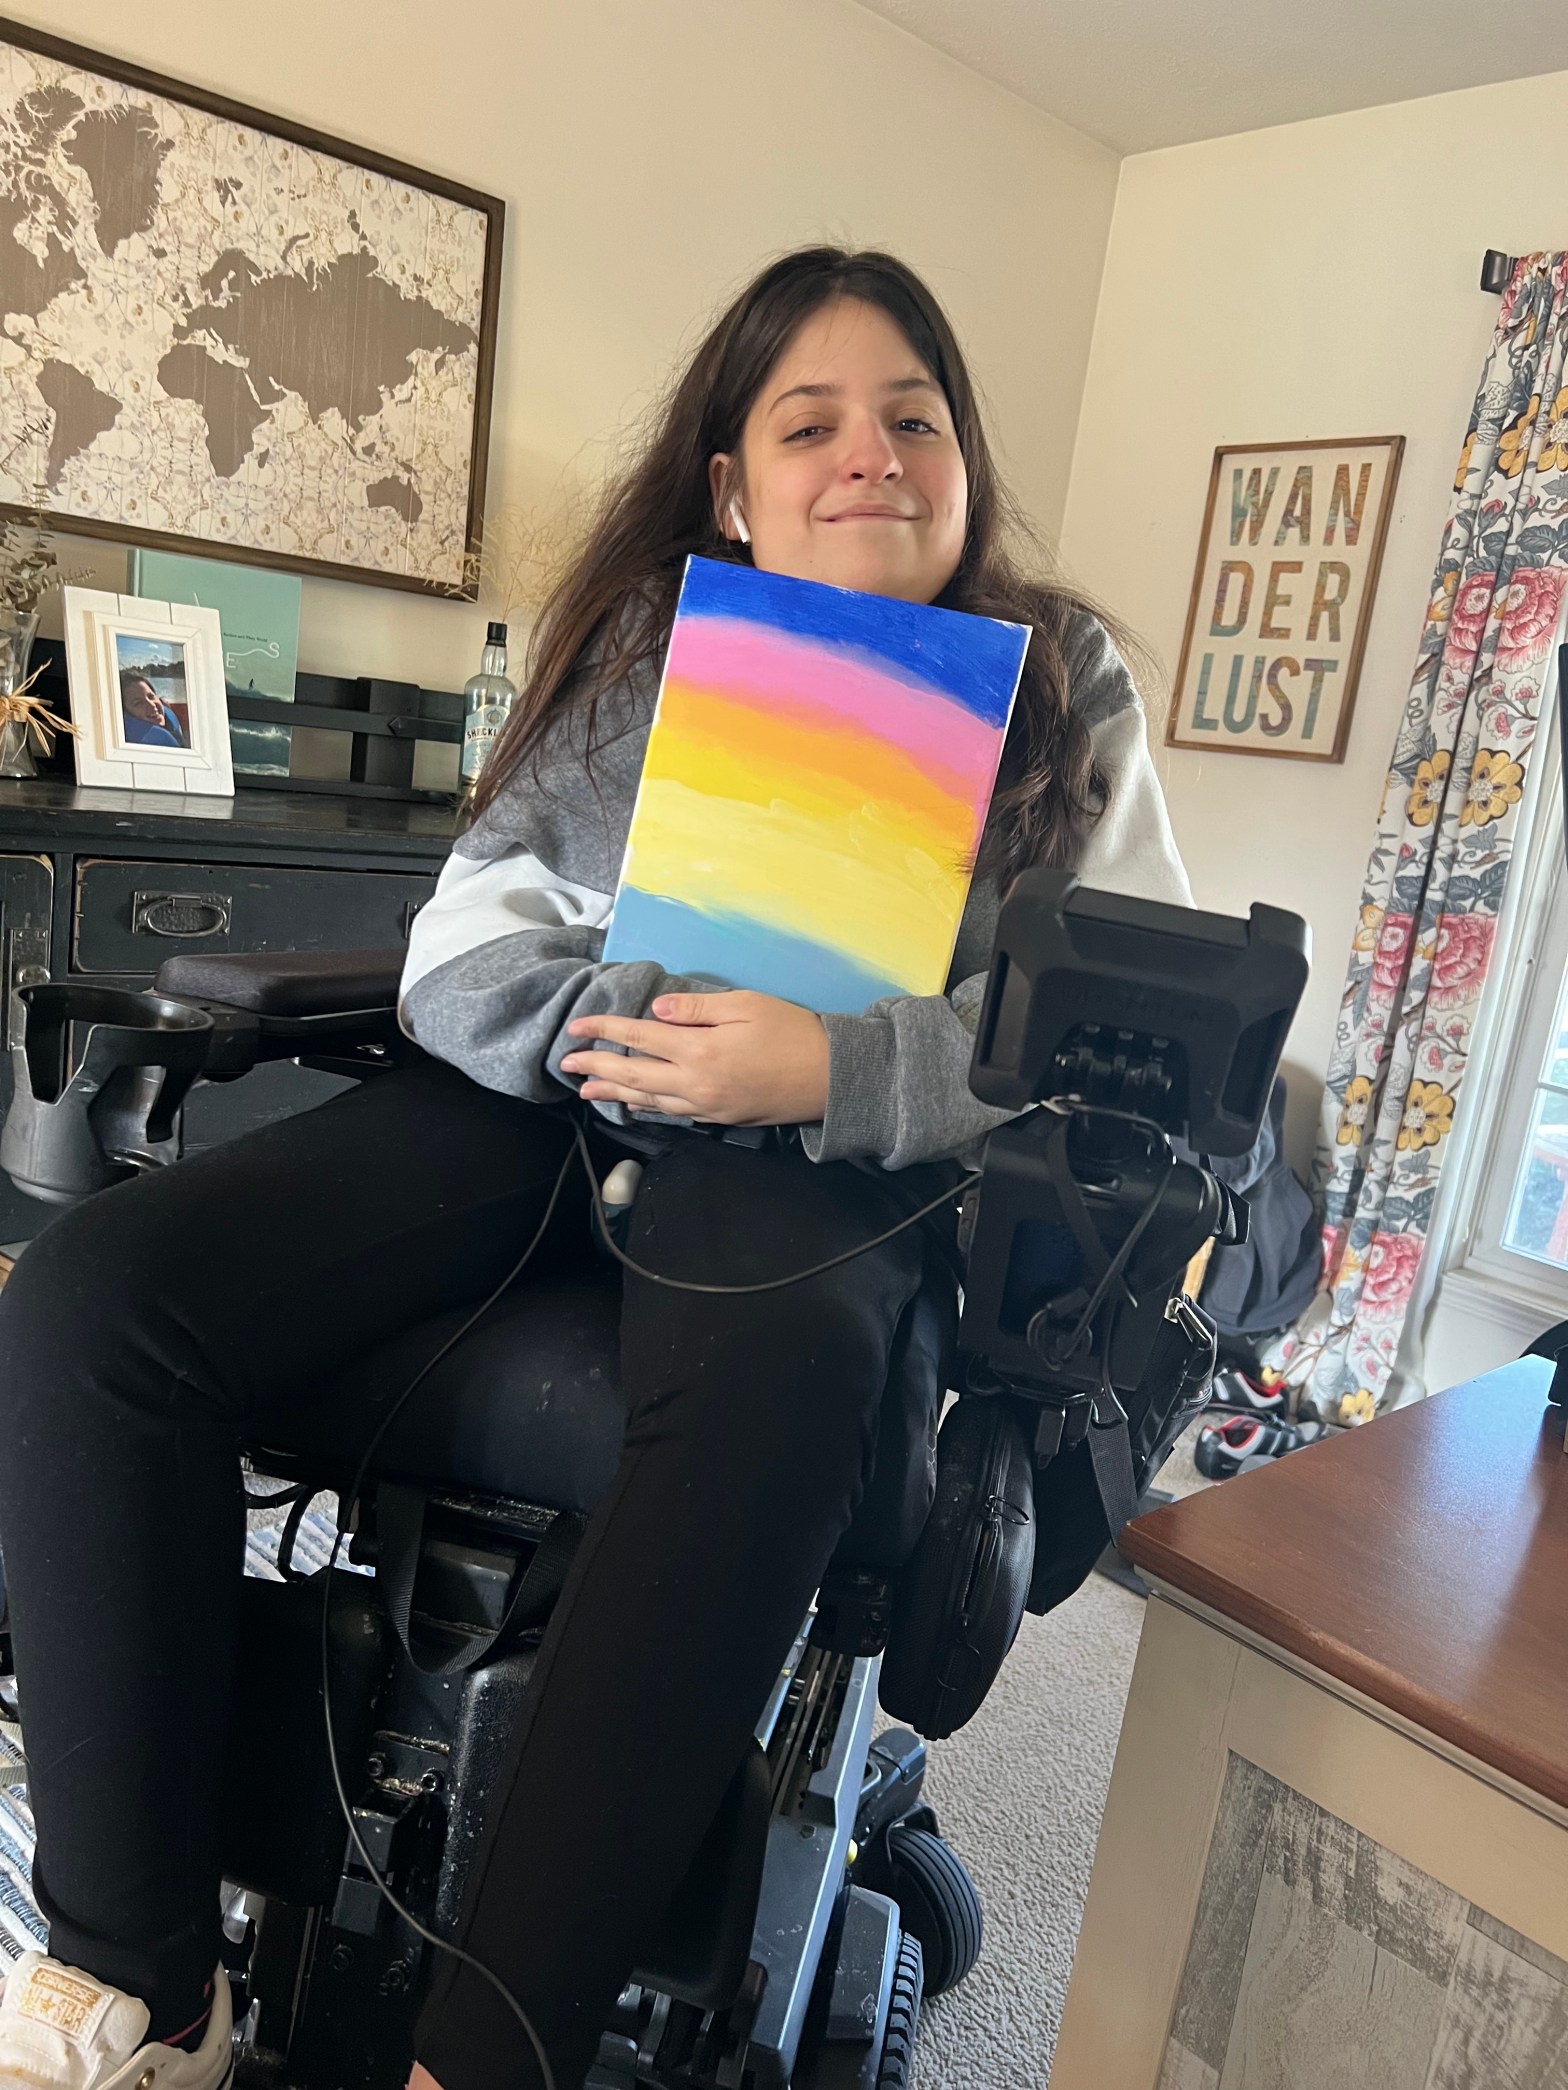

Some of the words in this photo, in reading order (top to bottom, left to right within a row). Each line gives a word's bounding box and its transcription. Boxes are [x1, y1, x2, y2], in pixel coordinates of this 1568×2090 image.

[1229, 462, 1373, 547] WAN
[1209, 560, 1351, 642] DER
[1191, 652, 1340, 740] LUST
